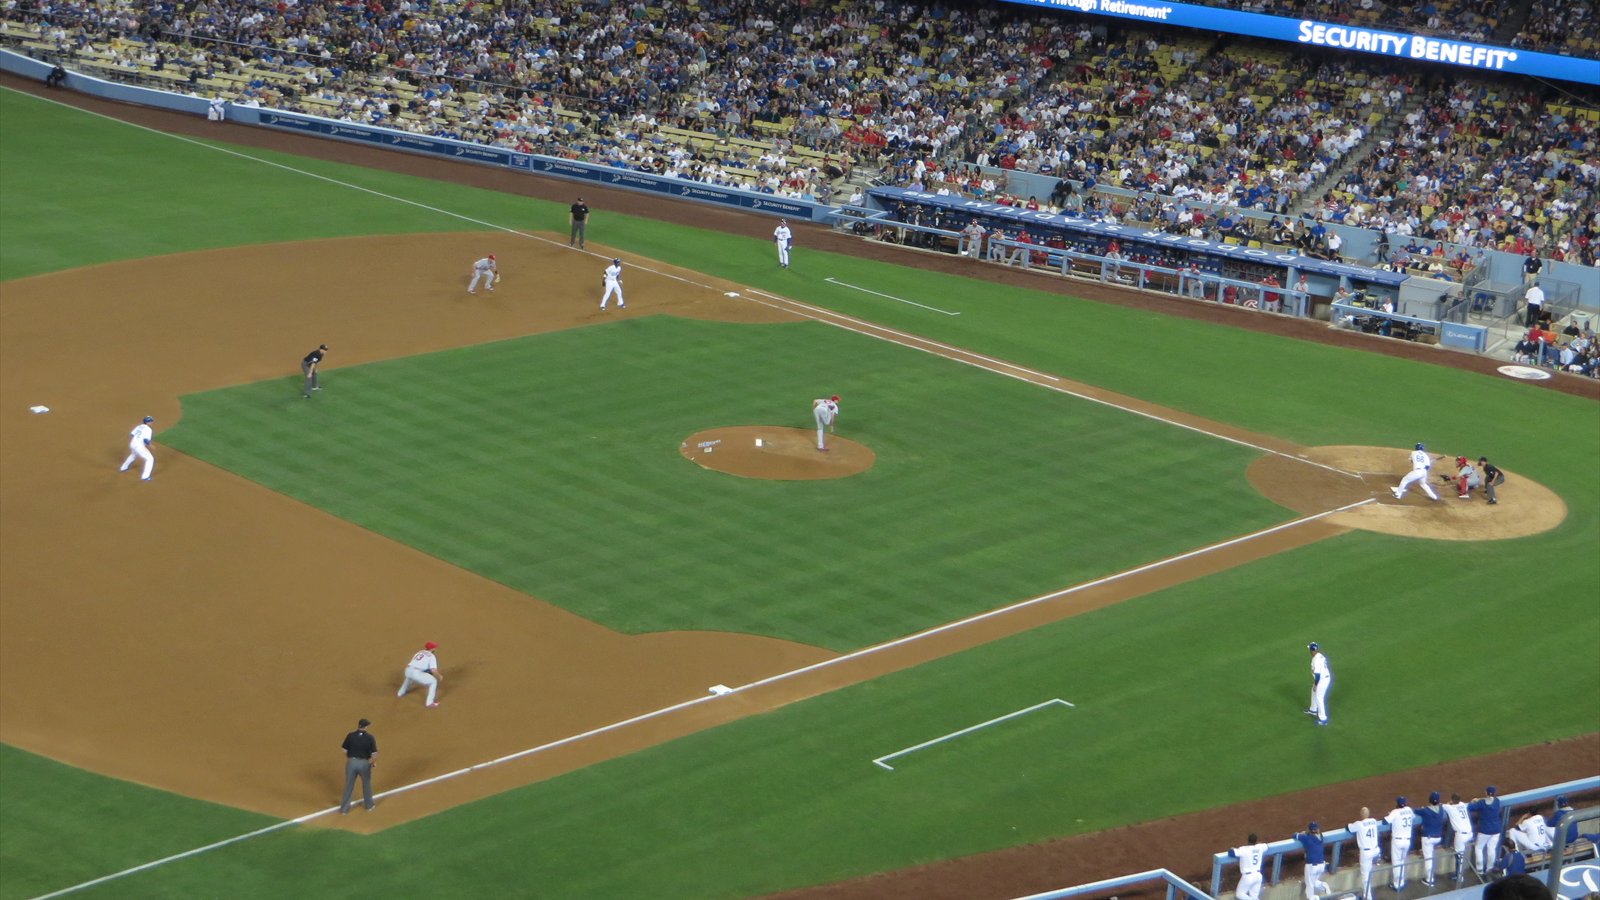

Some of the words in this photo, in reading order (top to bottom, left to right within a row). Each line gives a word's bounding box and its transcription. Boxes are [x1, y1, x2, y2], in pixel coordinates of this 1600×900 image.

[1050, 0, 1098, 12] rough
[1298, 20, 1407, 55] SECURITY
[1402, 816, 1412, 828] 33
[1366, 827, 1375, 839] 41
[1537, 824, 1545, 836] 16
[1252, 854, 1259, 866] 5
